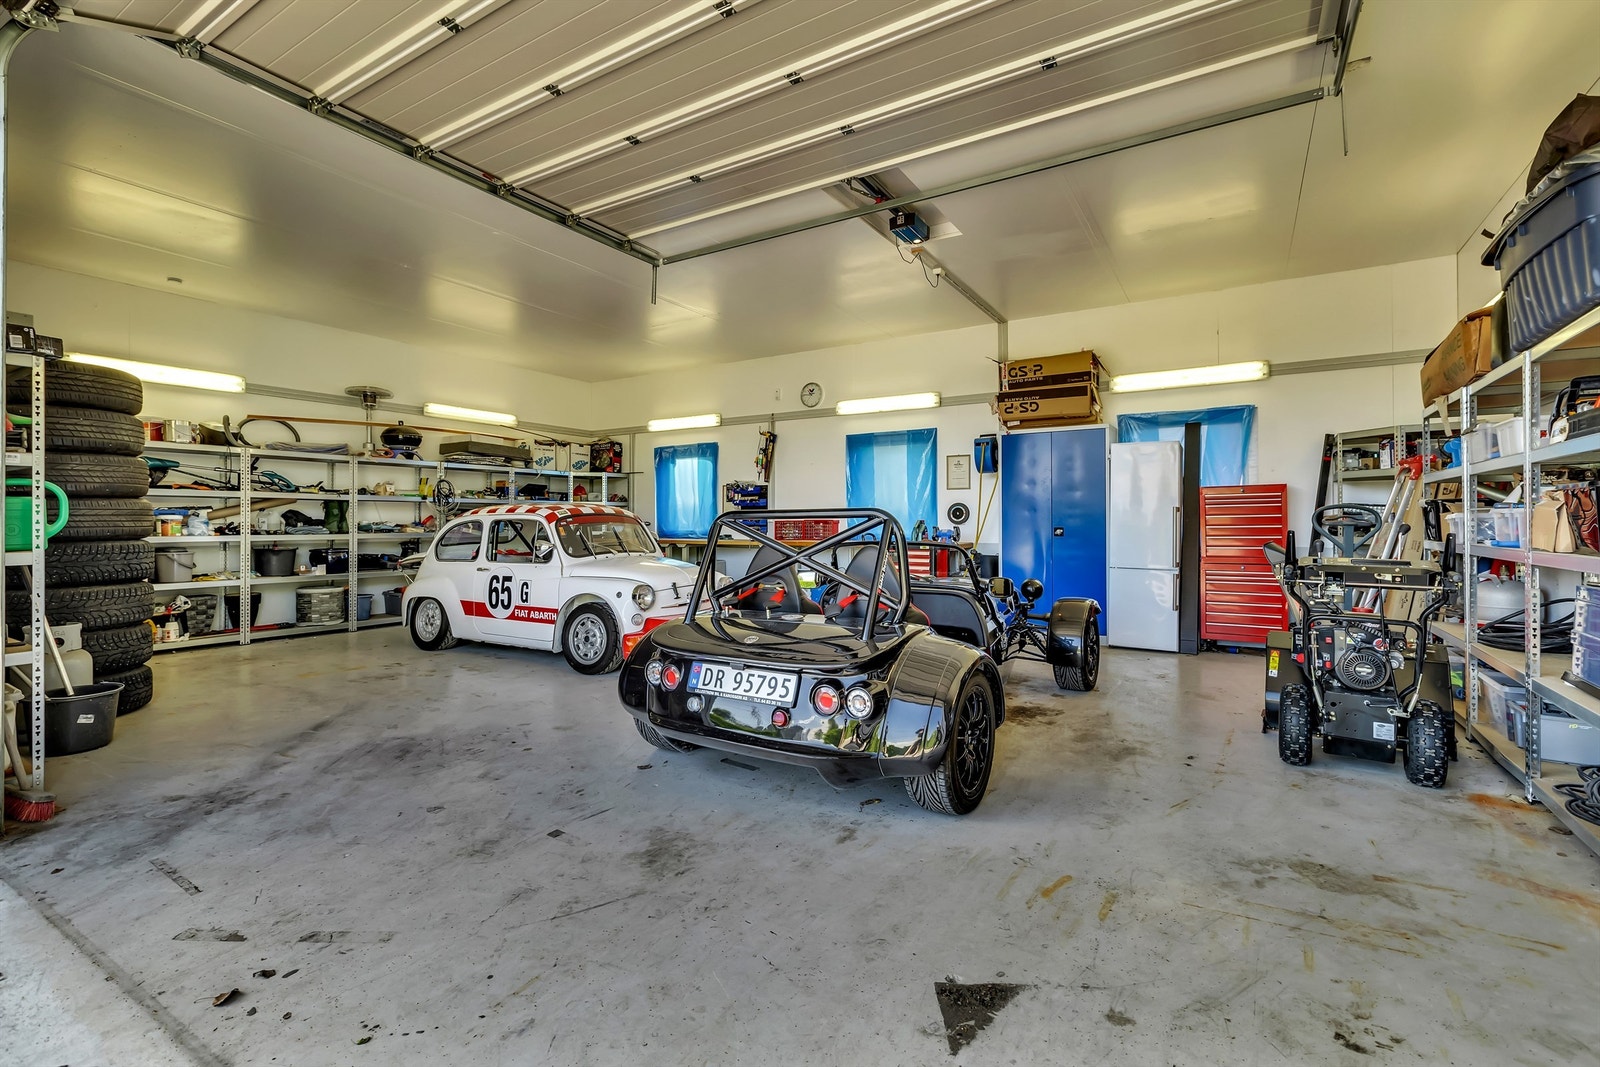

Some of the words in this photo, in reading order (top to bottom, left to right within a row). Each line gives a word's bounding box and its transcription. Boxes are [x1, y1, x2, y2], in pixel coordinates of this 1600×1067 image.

[488, 574, 513, 610] 65
[520, 582, 529, 603] G
[514, 609, 528, 618] FIAT
[530, 611, 557, 620] ABARTH
[702, 668, 725, 689] DR
[732, 672, 791, 698] 95795
